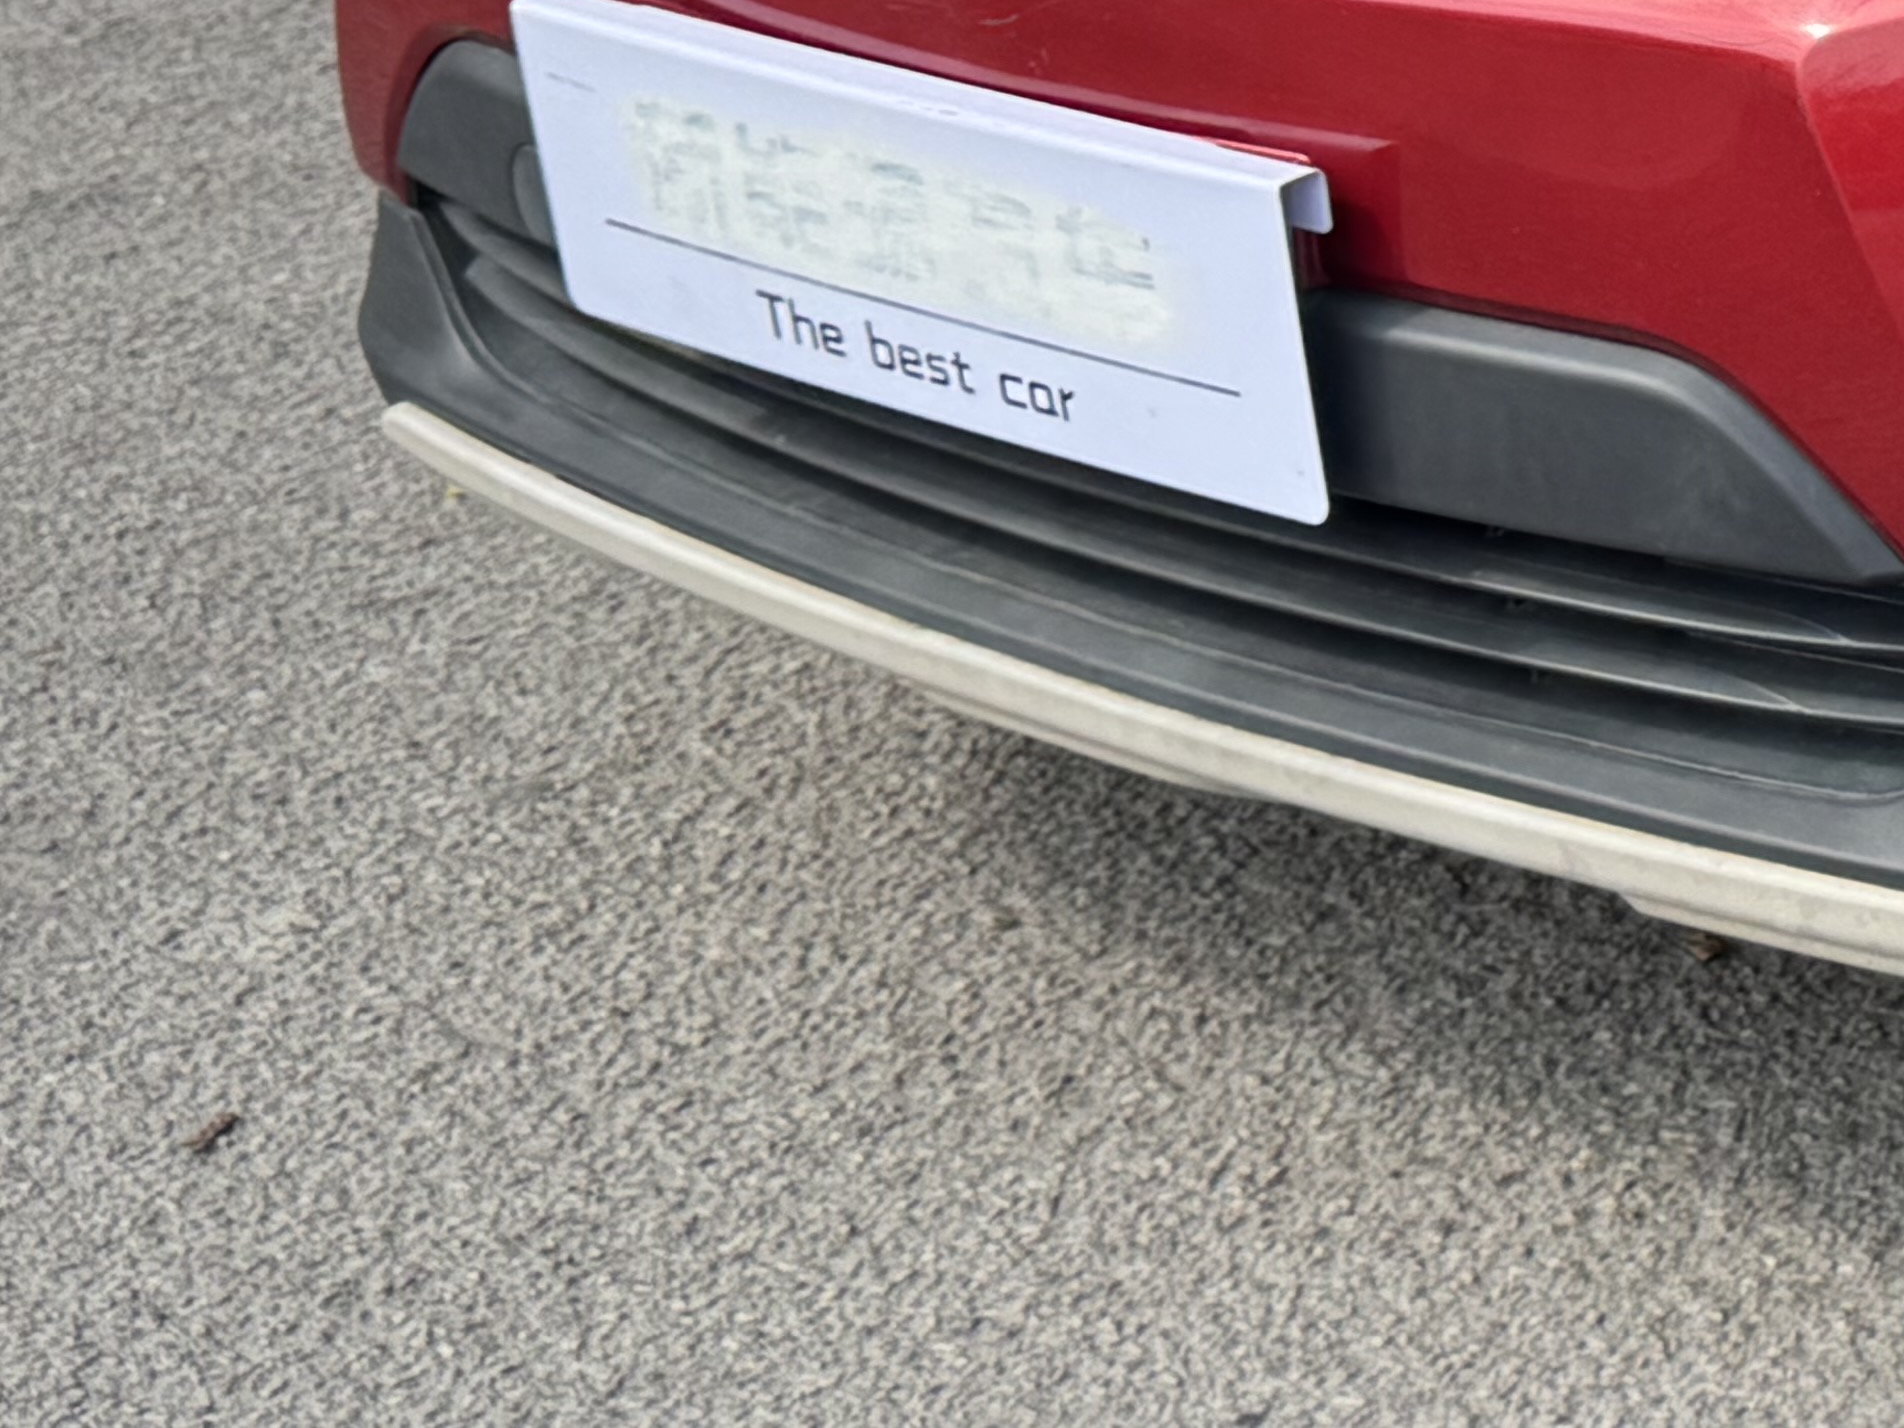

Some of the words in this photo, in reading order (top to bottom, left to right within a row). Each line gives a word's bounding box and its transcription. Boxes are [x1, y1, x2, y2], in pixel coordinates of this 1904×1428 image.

[756, 289, 847, 357] The
[865, 320, 976, 395] best
[998, 373, 1075, 422] car
